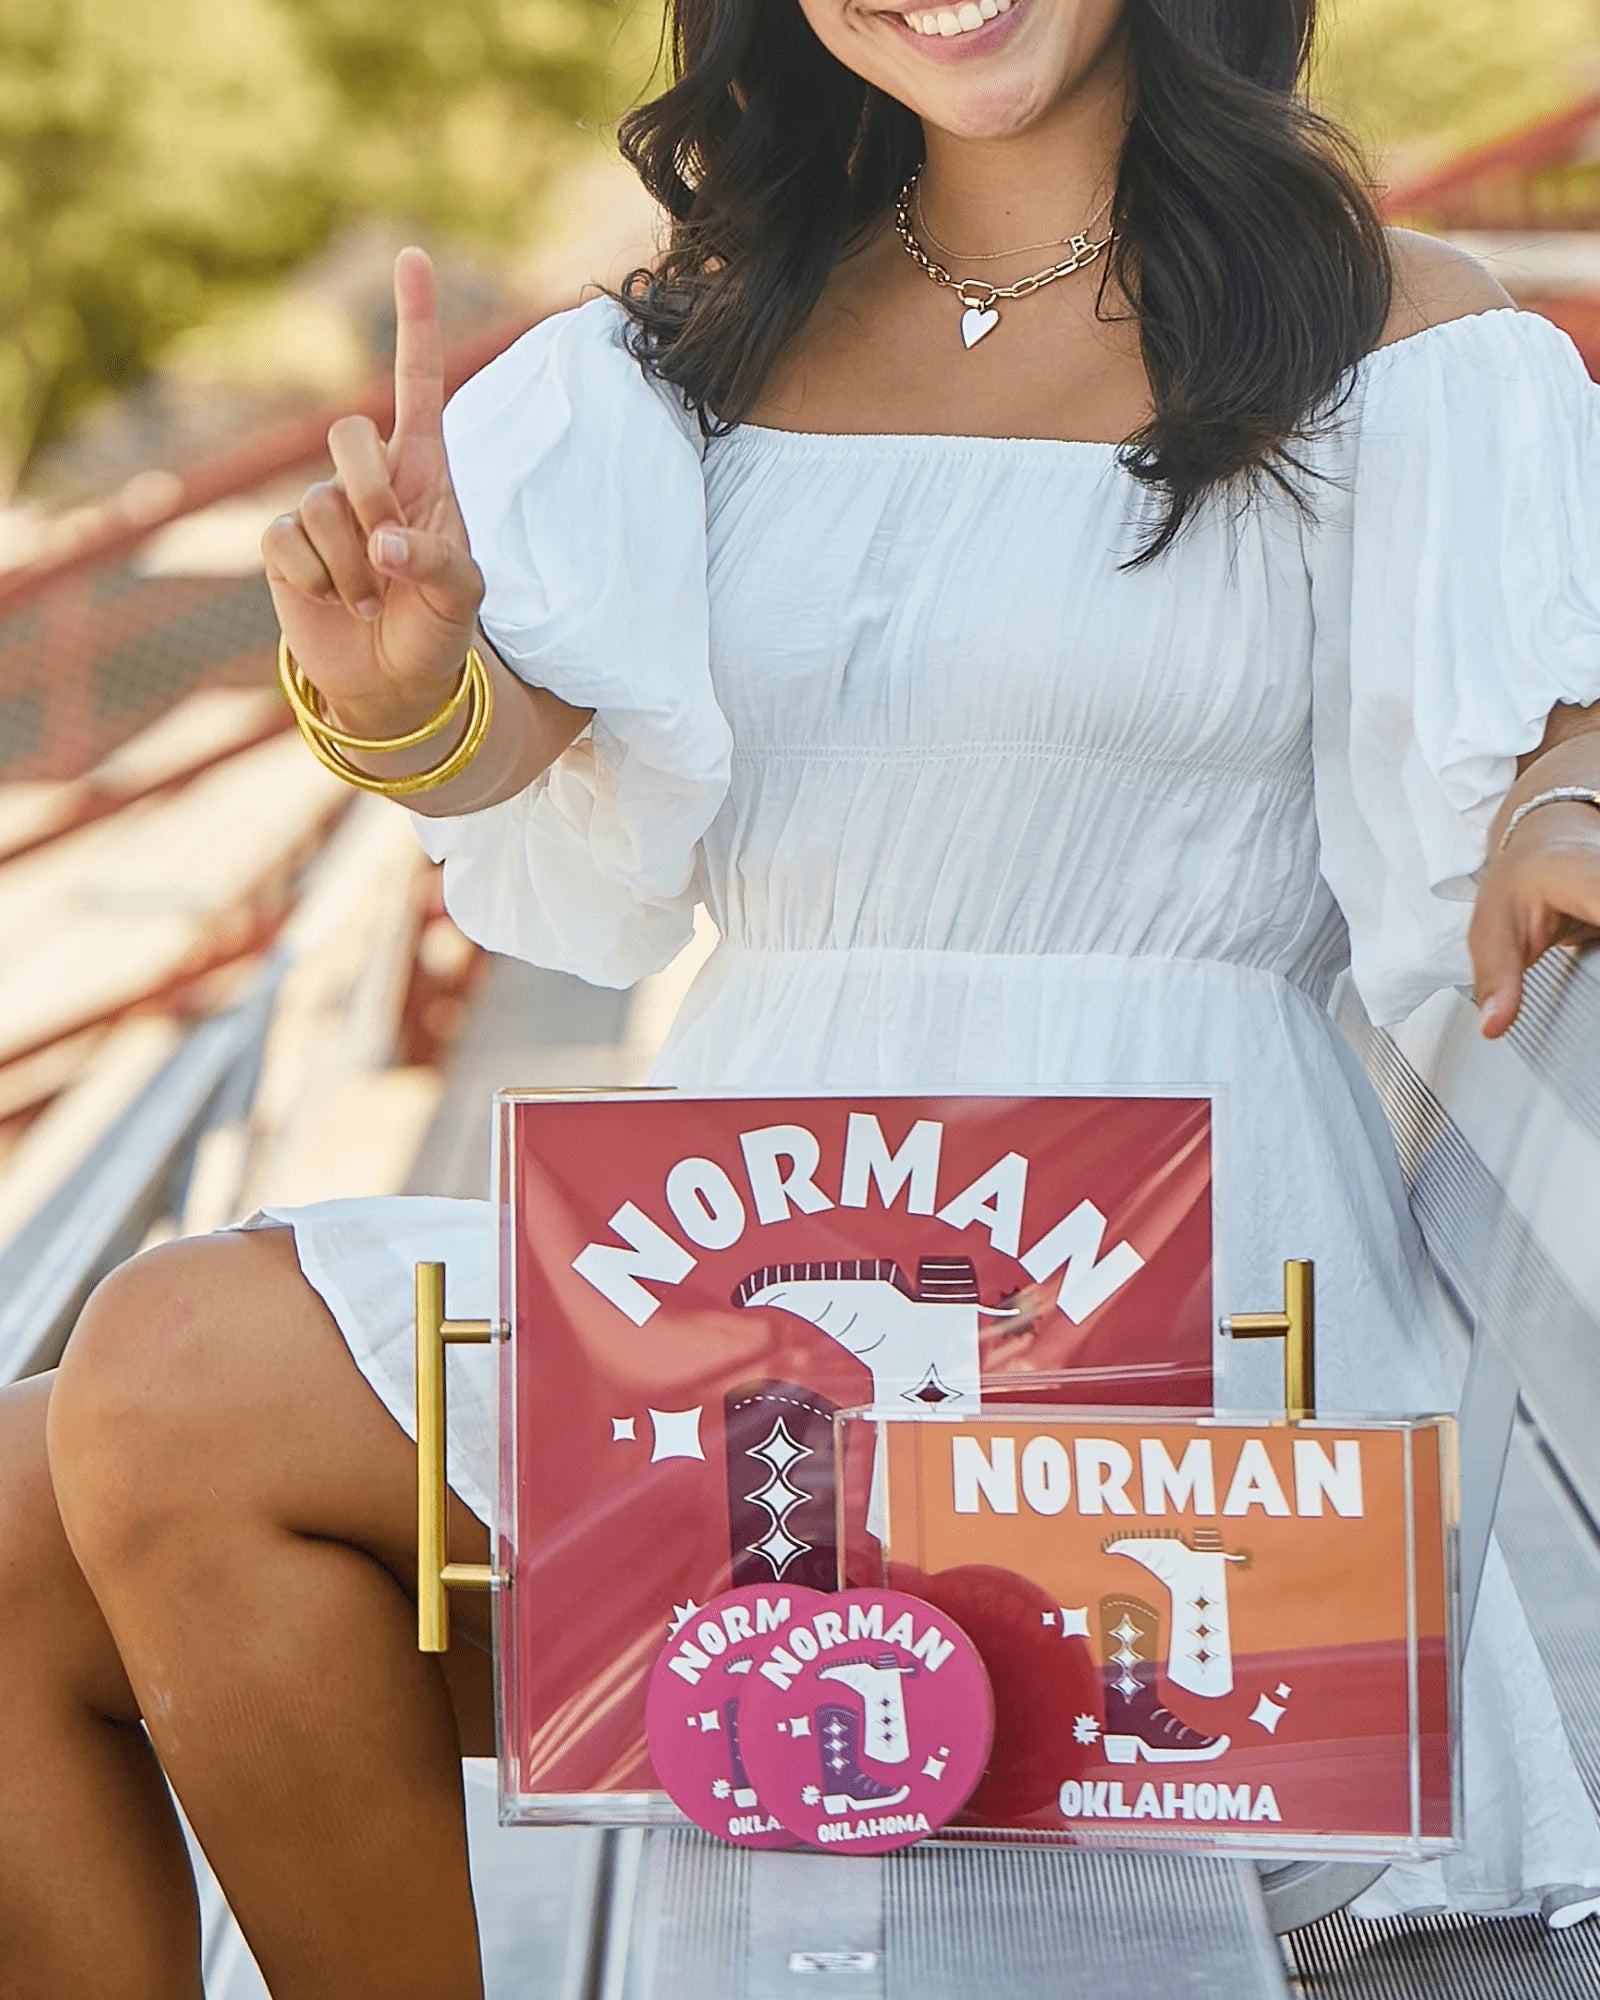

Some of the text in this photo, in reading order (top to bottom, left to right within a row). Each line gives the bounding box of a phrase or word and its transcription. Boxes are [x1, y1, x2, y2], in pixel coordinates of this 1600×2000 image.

[571, 1112, 1146, 1327] NORMAN
[951, 1436, 1364, 1518] NORMAN
[759, 1604, 956, 1691] NORMAN
[728, 1815, 784, 1837] OKLA
[817, 1812, 930, 1844] OKLAHOMA
[1059, 1780, 1283, 1823] OKLAHOMA
